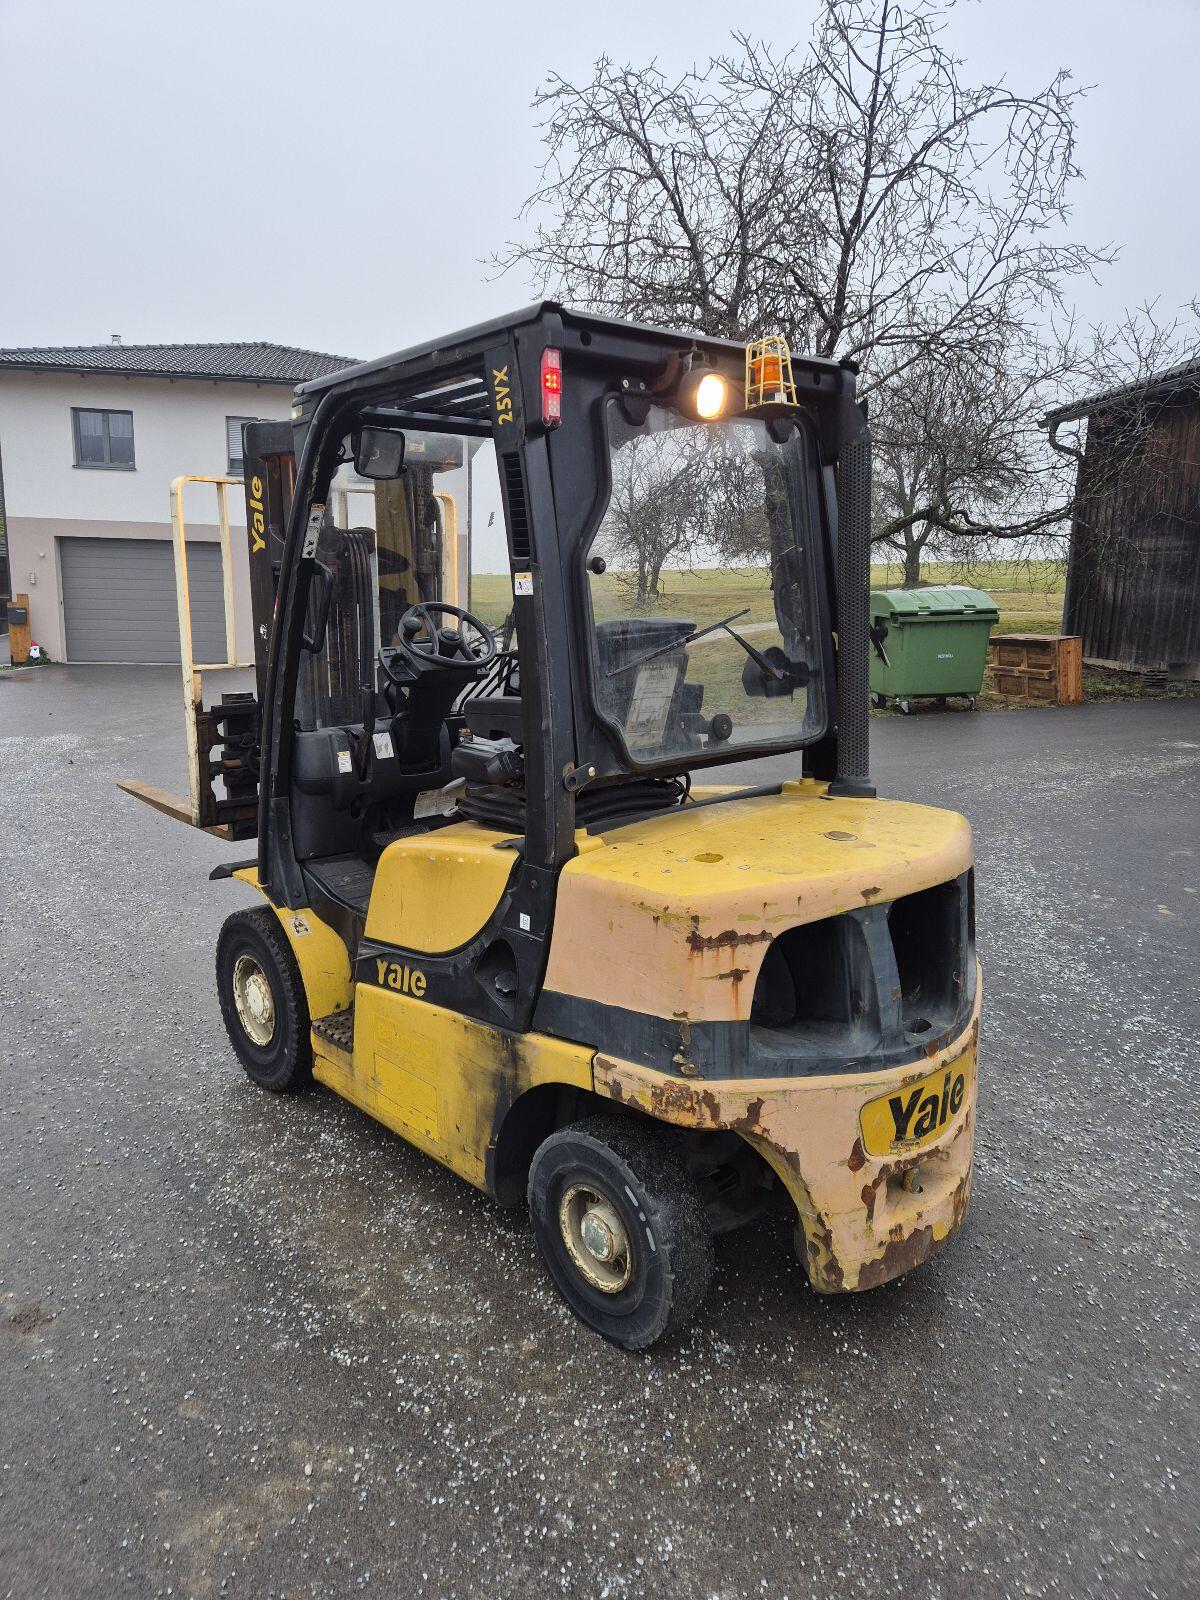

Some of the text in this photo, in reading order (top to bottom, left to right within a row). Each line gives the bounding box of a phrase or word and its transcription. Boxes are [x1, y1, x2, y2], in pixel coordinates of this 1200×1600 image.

[493, 365, 513, 425] 25VX
[250, 475, 266, 553] Yale
[376, 958, 427, 997] Yale
[888, 1070, 965, 1142] Yale
